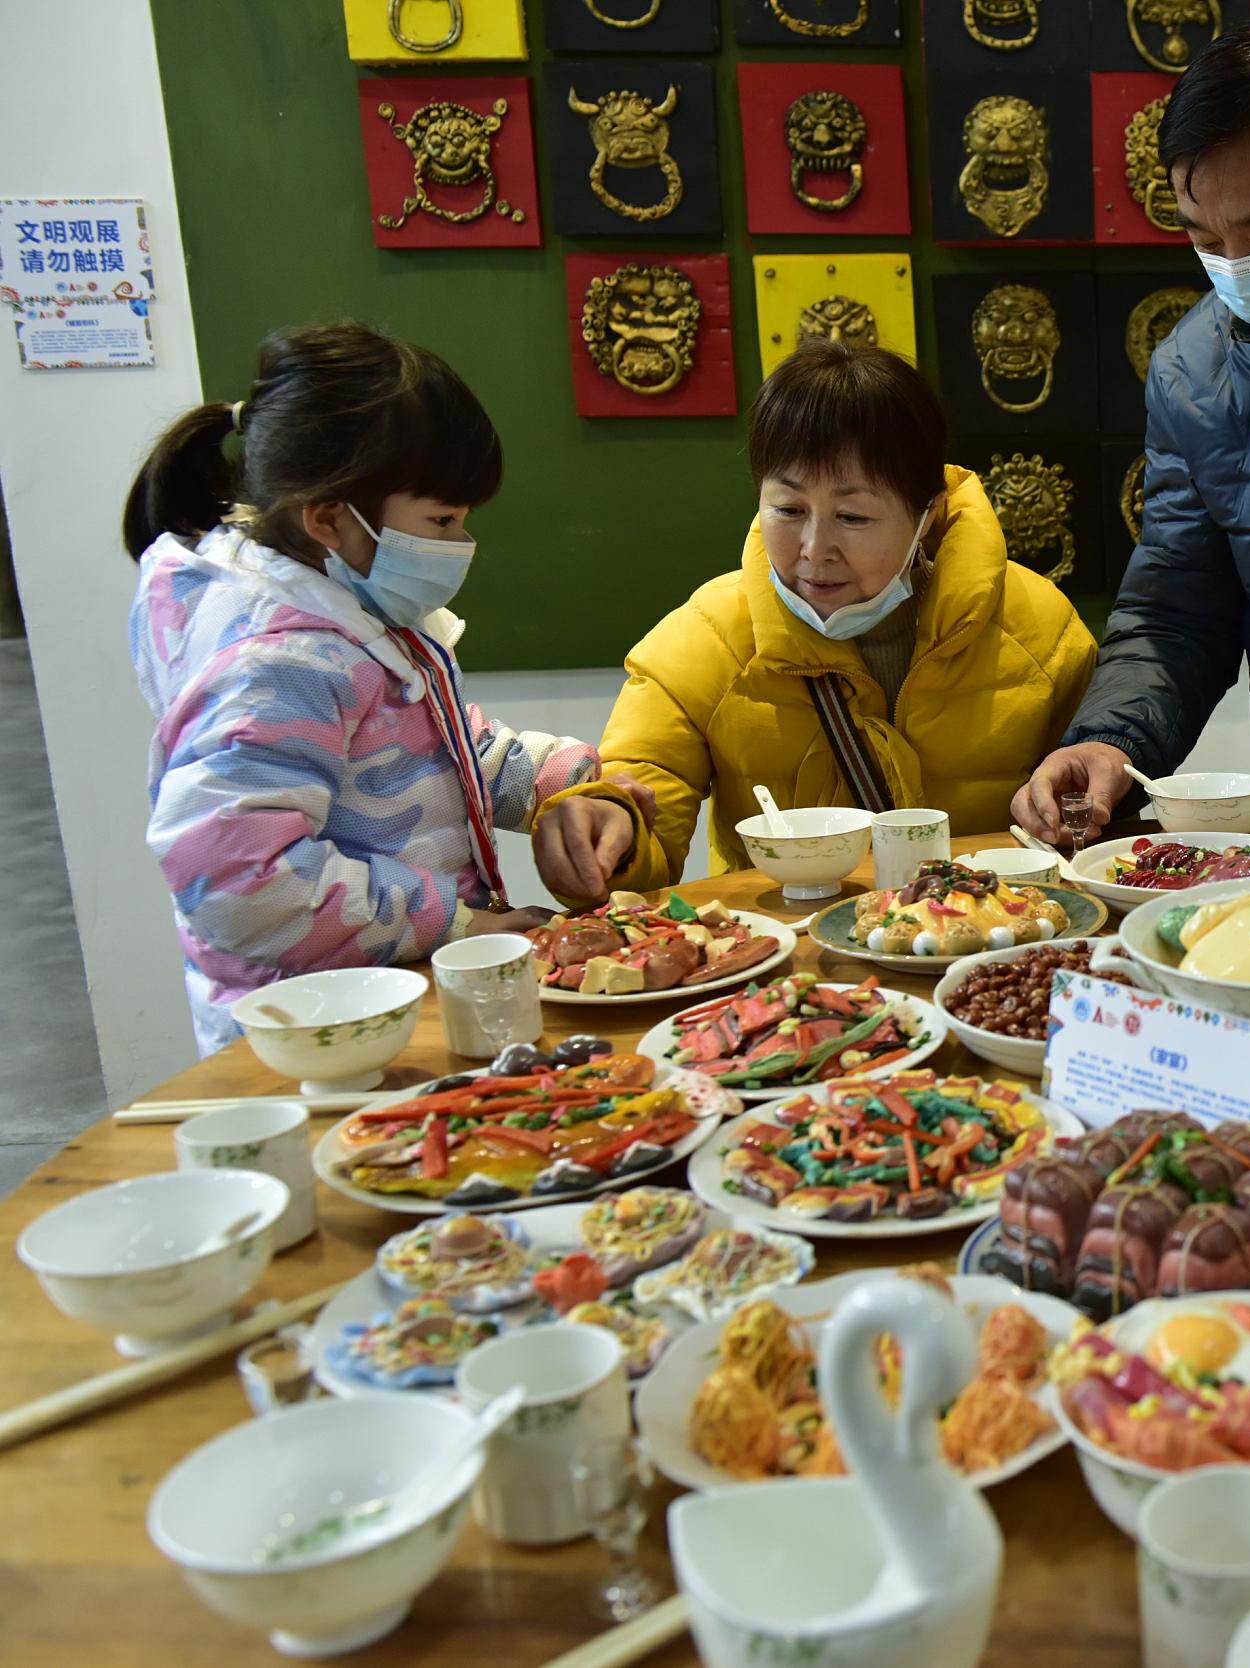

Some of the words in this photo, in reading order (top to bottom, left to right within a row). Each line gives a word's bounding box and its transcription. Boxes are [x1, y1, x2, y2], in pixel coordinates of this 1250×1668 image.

[15, 220, 121, 244] 文明观展
[20, 249, 125, 273] 请勿触摸
